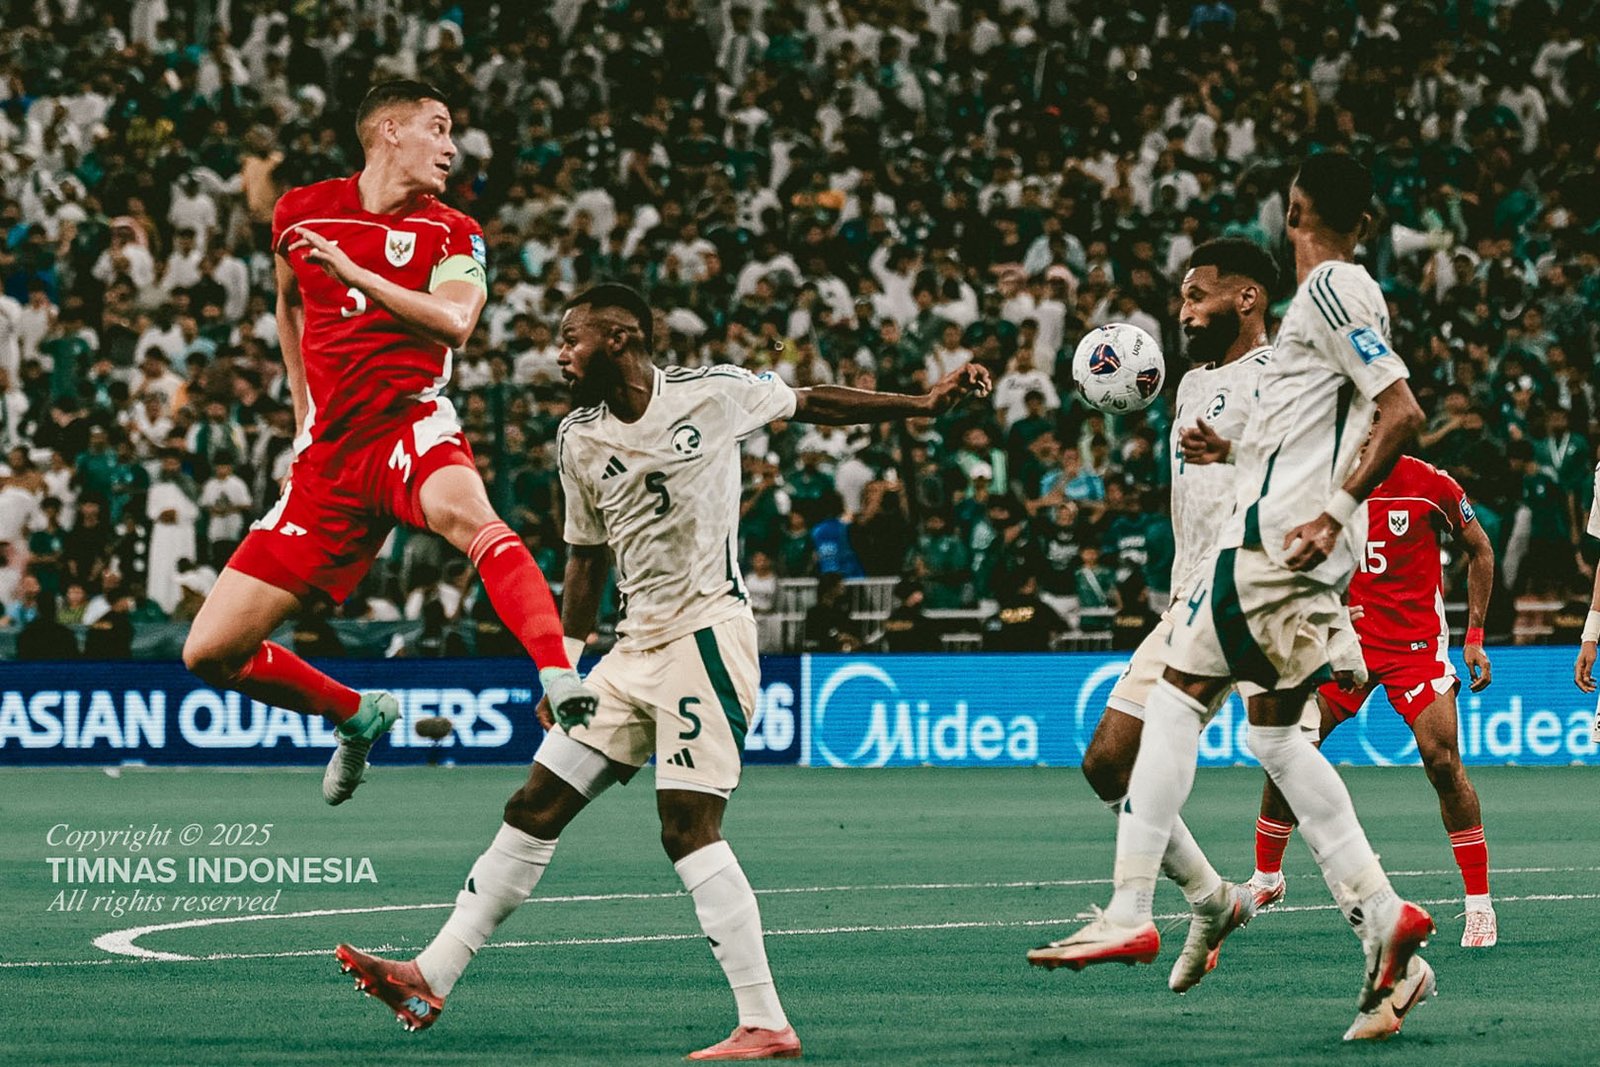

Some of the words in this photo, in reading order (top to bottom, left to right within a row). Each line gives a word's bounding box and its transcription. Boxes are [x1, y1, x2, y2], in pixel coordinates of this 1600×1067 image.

[645, 471, 670, 515] 5
[1187, 578, 1207, 627] 4
[0, 690, 166, 748] ASIAN
[678, 696, 702, 740] 5
[850, 700, 1039, 760] Midea
[1457, 696, 1598, 756] idea
